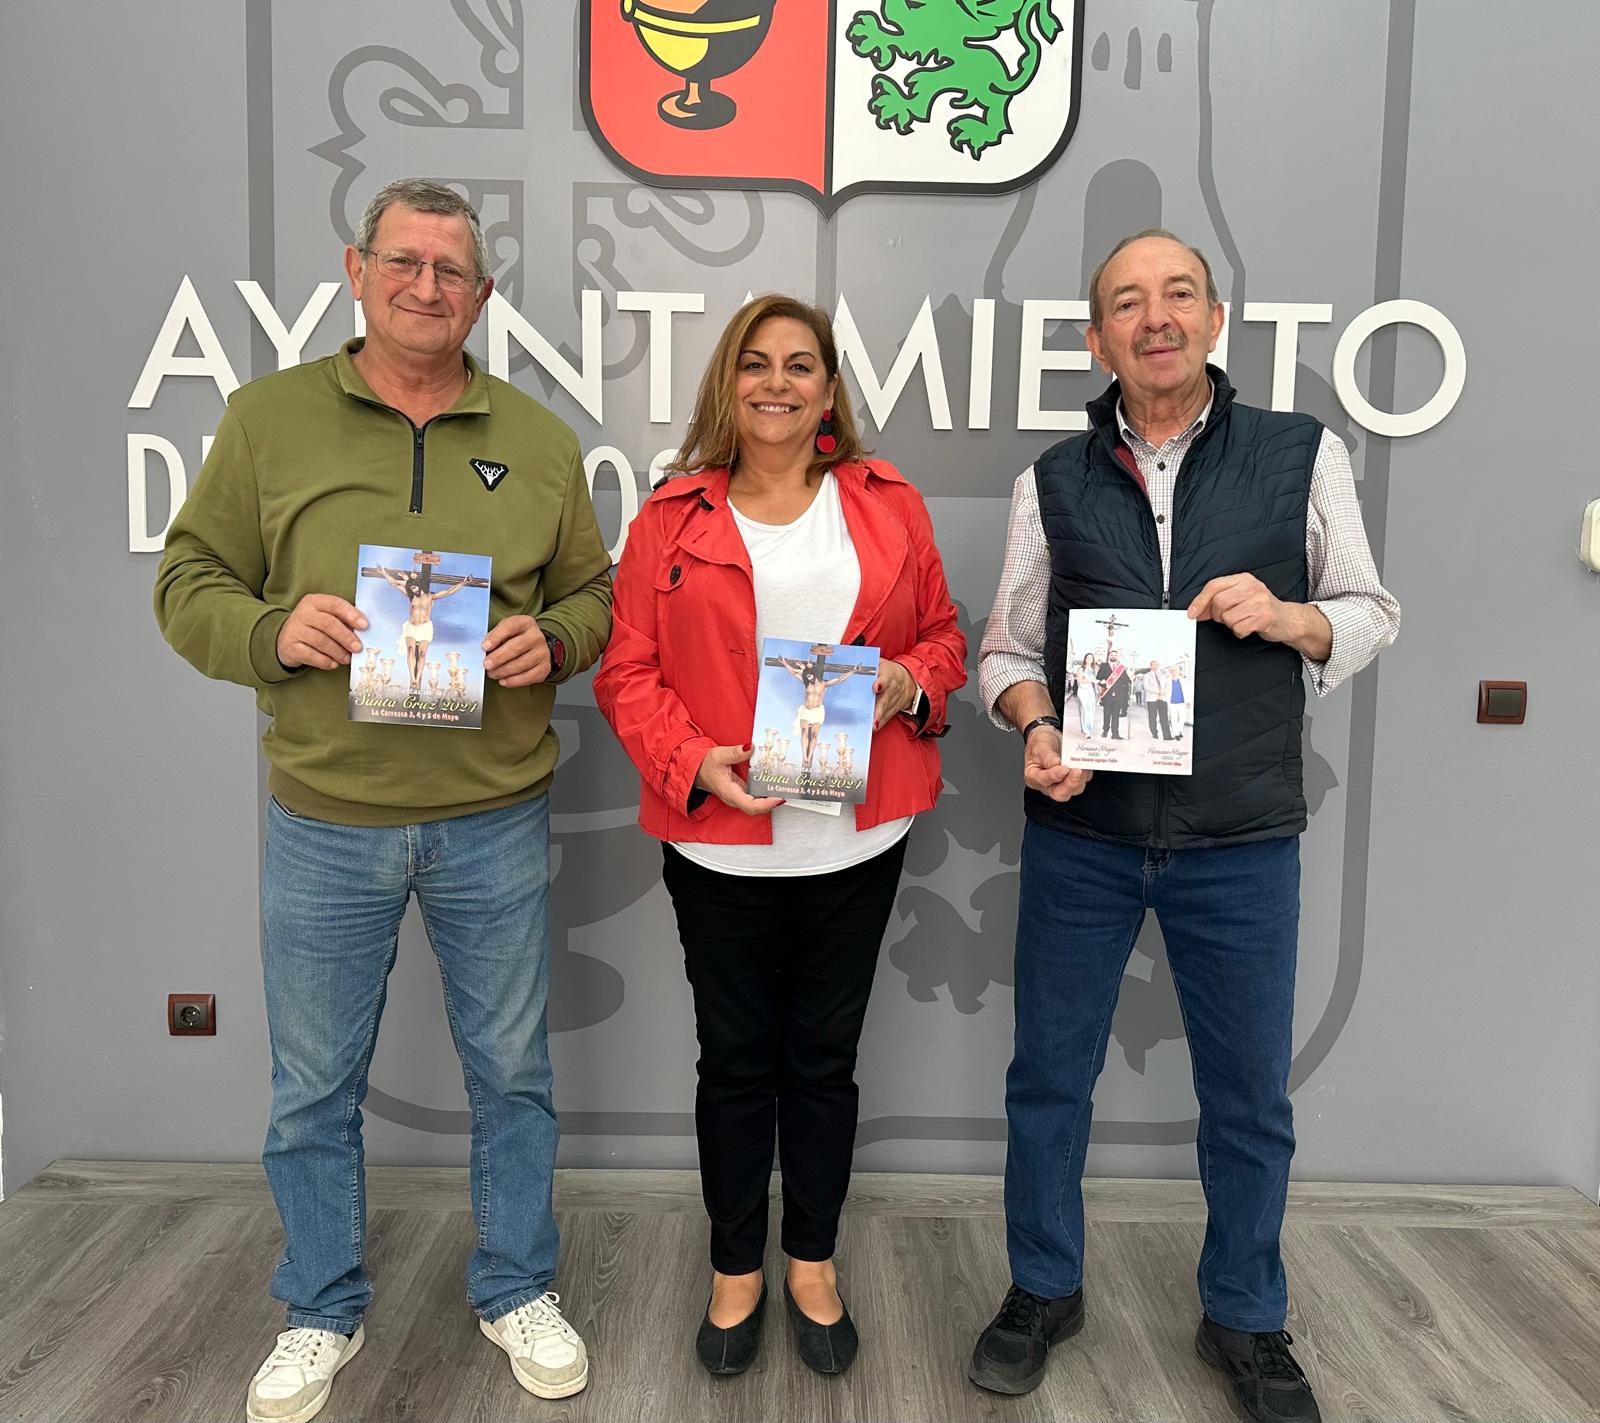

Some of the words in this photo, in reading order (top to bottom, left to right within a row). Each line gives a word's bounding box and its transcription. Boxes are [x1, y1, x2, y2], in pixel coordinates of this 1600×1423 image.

[127, 273, 1467, 437] AYNTMIETO
[127, 433, 216, 554] D
[354, 692, 398, 708] Santa
[402, 695, 438, 710] Cruz
[371, 708, 379, 716] La
[442, 713, 459, 722] Mayo
[753, 769, 790, 785] Santa
[795, 774, 826, 788] Cruz
[829, 790, 845, 798] Mayo
